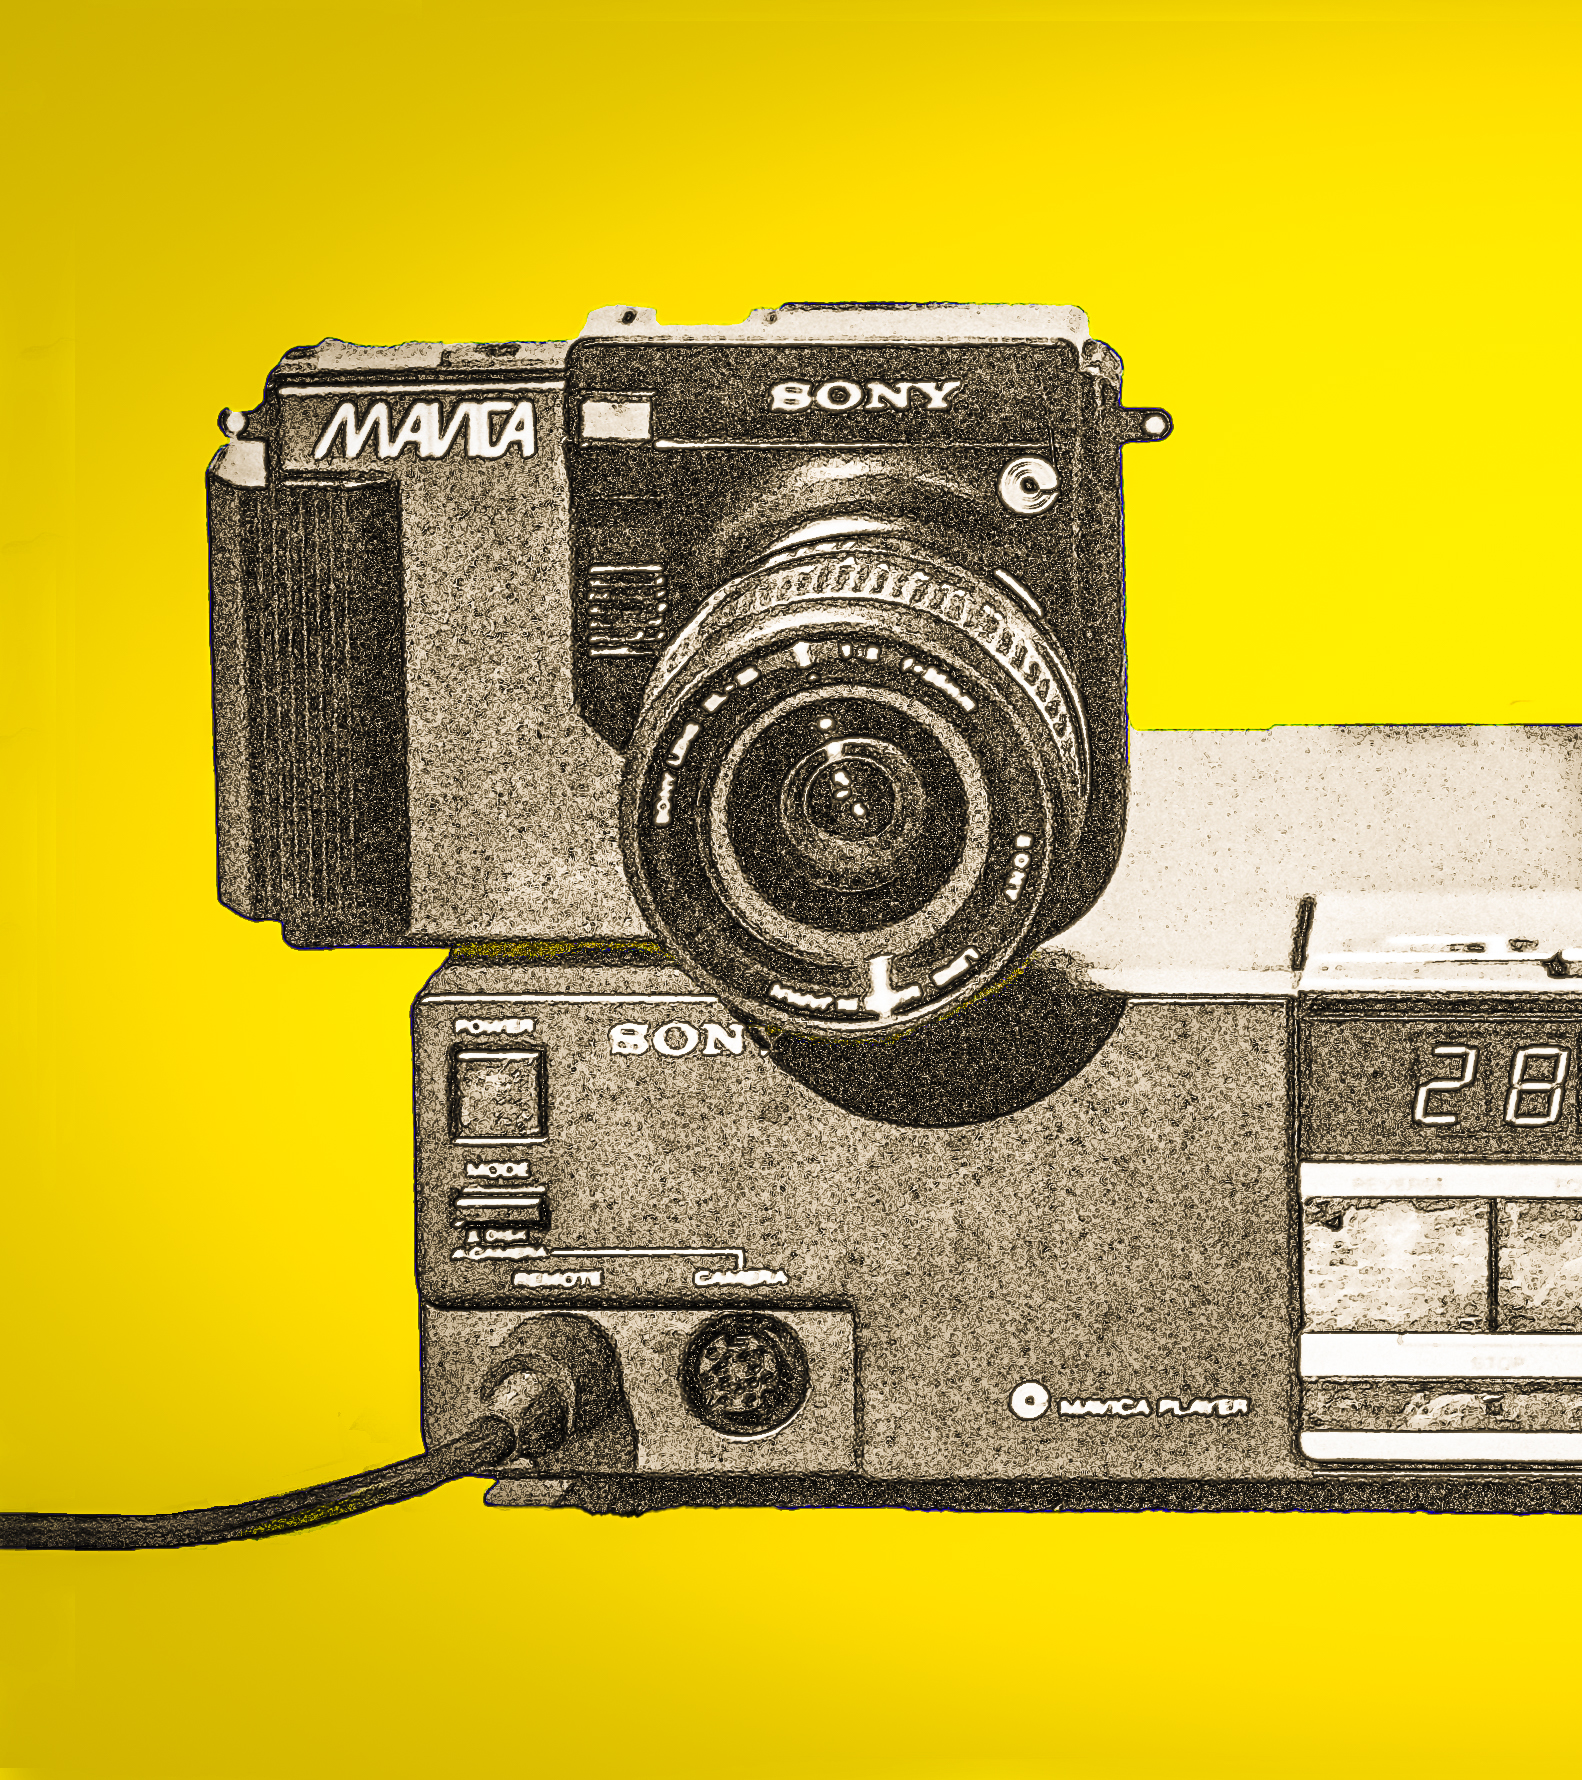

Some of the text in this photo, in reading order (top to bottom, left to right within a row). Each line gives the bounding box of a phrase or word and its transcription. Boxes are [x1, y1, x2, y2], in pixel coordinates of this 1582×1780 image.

[768, 381, 962, 411] SONY
[313, 401, 538, 460] MAVICA
[454, 1018, 535, 1035] POWER
[608, 1021, 746, 1057] SON
[1415, 1045, 1569, 1125] 28
[466, 1162, 529, 1178] MODE
[513, 1270, 602, 1288] REMOTE
[694, 1269, 789, 1287] CAMERA
[1059, 1398, 1248, 1417] MAVICA PLAYER
